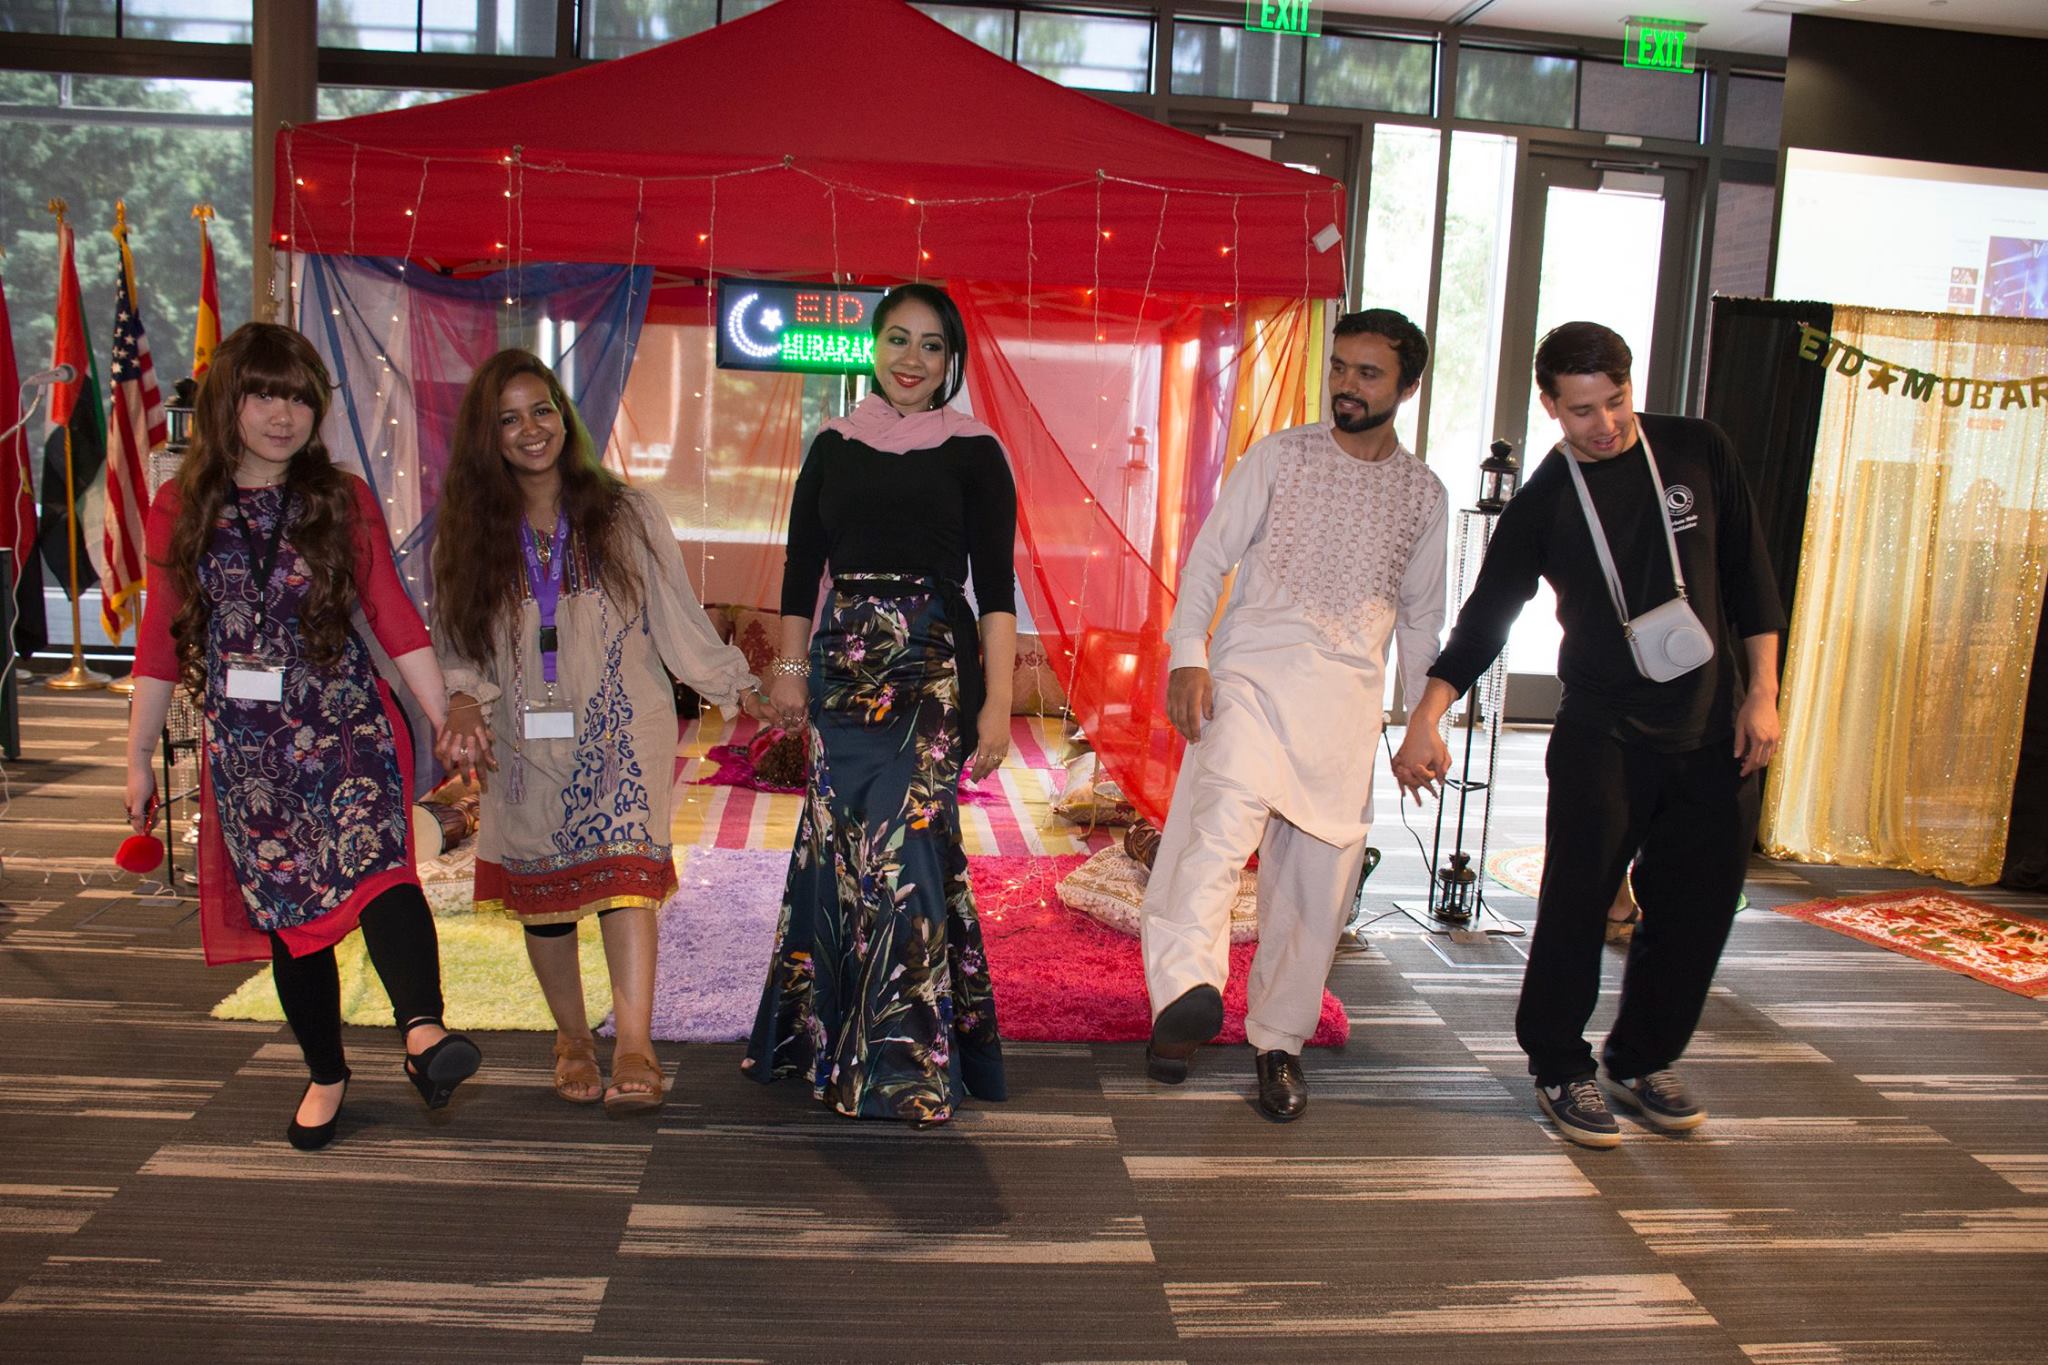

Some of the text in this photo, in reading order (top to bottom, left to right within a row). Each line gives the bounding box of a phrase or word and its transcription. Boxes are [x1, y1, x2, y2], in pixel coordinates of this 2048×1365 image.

[1260, 0, 1311, 32] EXIT
[1638, 27, 1687, 68] EXIT
[796, 292, 864, 324] EID
[782, 332, 875, 364] MUBARAK
[1798, 326, 1865, 377] EID
